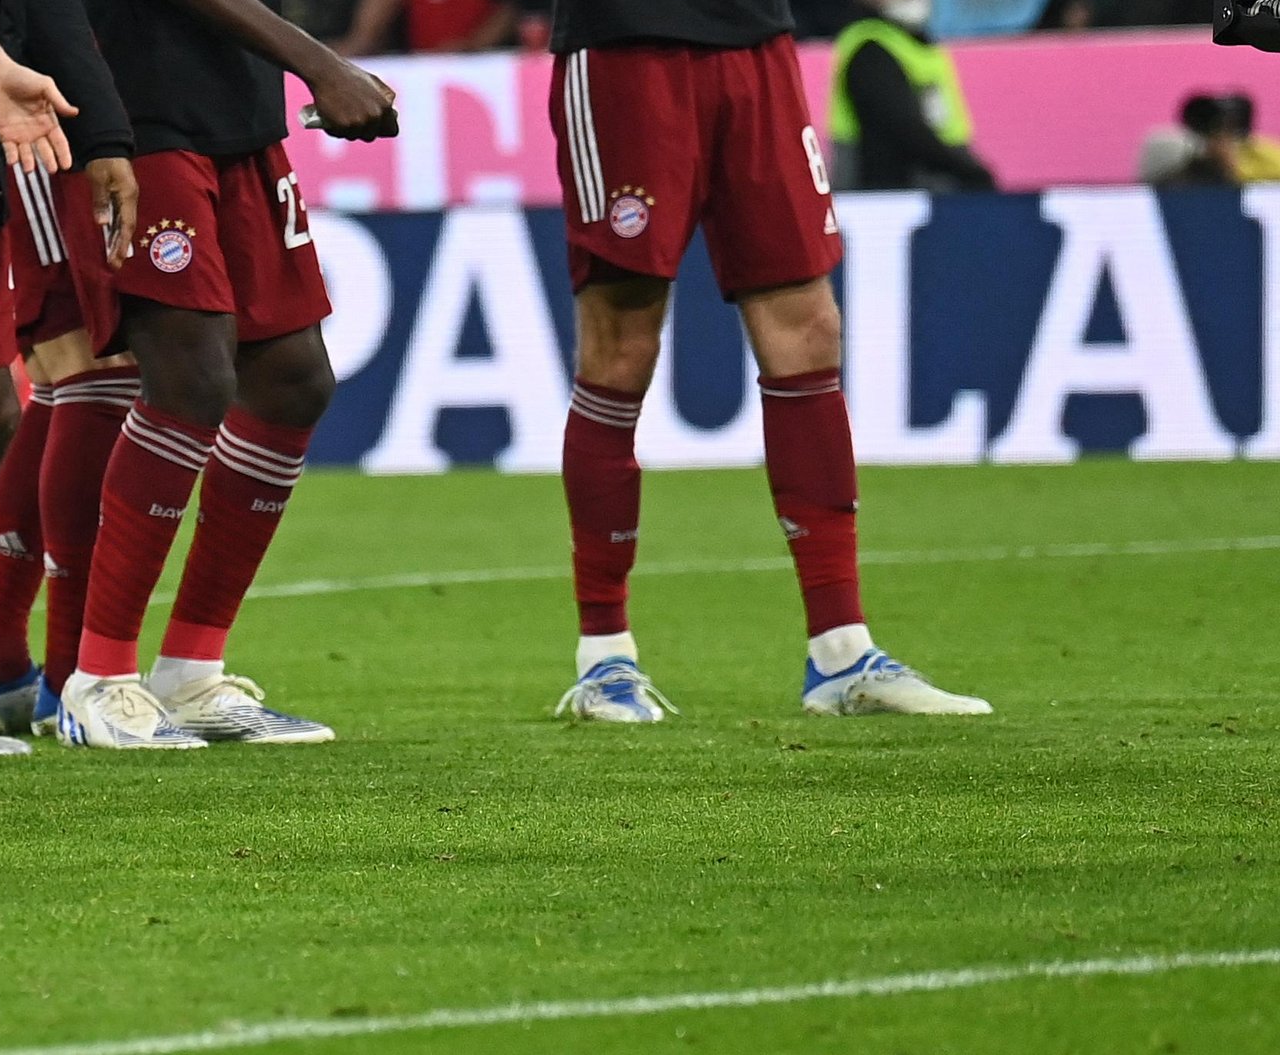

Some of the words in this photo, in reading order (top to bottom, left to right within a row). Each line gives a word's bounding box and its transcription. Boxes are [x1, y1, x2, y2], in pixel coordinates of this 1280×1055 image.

[801, 125, 831, 195] 8
[276, 171, 312, 250] 2
[308, 182, 1280, 476] PAULA
